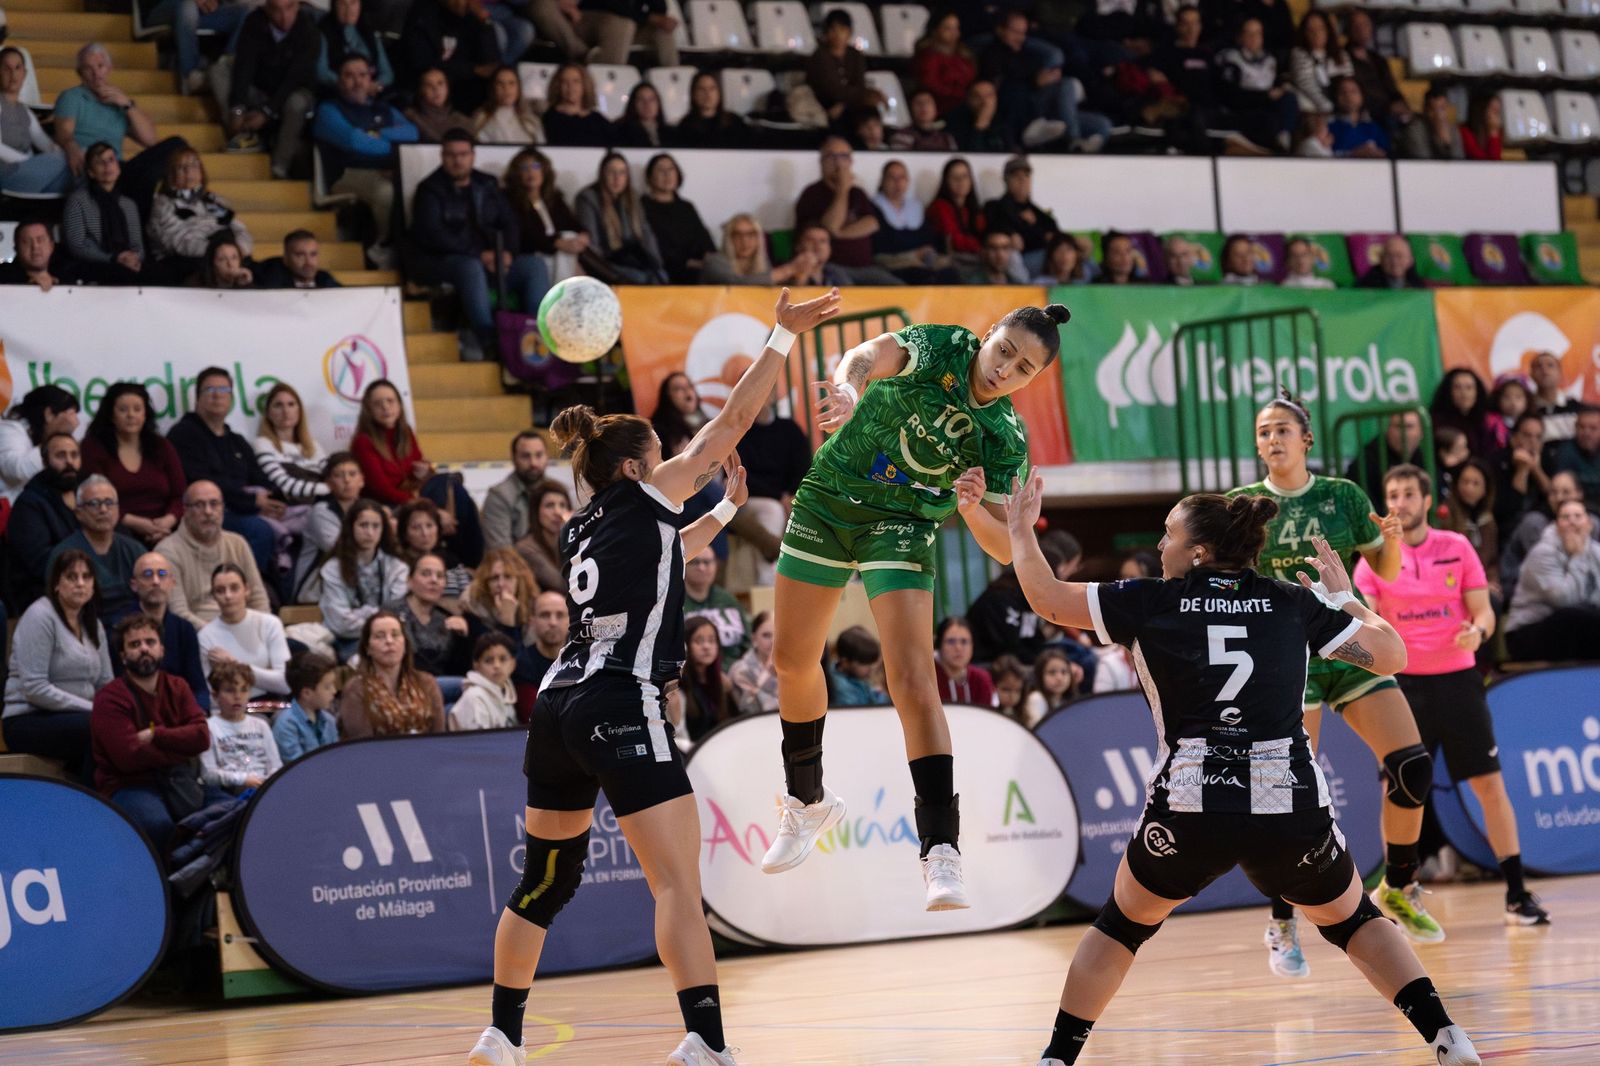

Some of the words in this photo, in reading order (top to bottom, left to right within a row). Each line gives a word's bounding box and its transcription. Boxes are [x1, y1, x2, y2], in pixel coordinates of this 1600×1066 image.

[1196, 341, 1419, 402] Iberdrola
[933, 404, 974, 439] 10
[792, 521, 818, 535] Gobierno
[796, 529, 824, 544] Canarias
[1278, 517, 1325, 551] 44
[568, 536, 600, 606] 6
[1271, 556, 1305, 568] ROC
[1179, 598, 1201, 613] DE
[1204, 598, 1273, 614] URIARTE
[1207, 625, 1254, 702] 5
[1149, 830, 1178, 856] CSIF
[312, 879, 396, 905] Diputación
[398, 870, 473, 894] Provincial
[355, 904, 376, 921] de
[379, 898, 436, 918] Málaga
